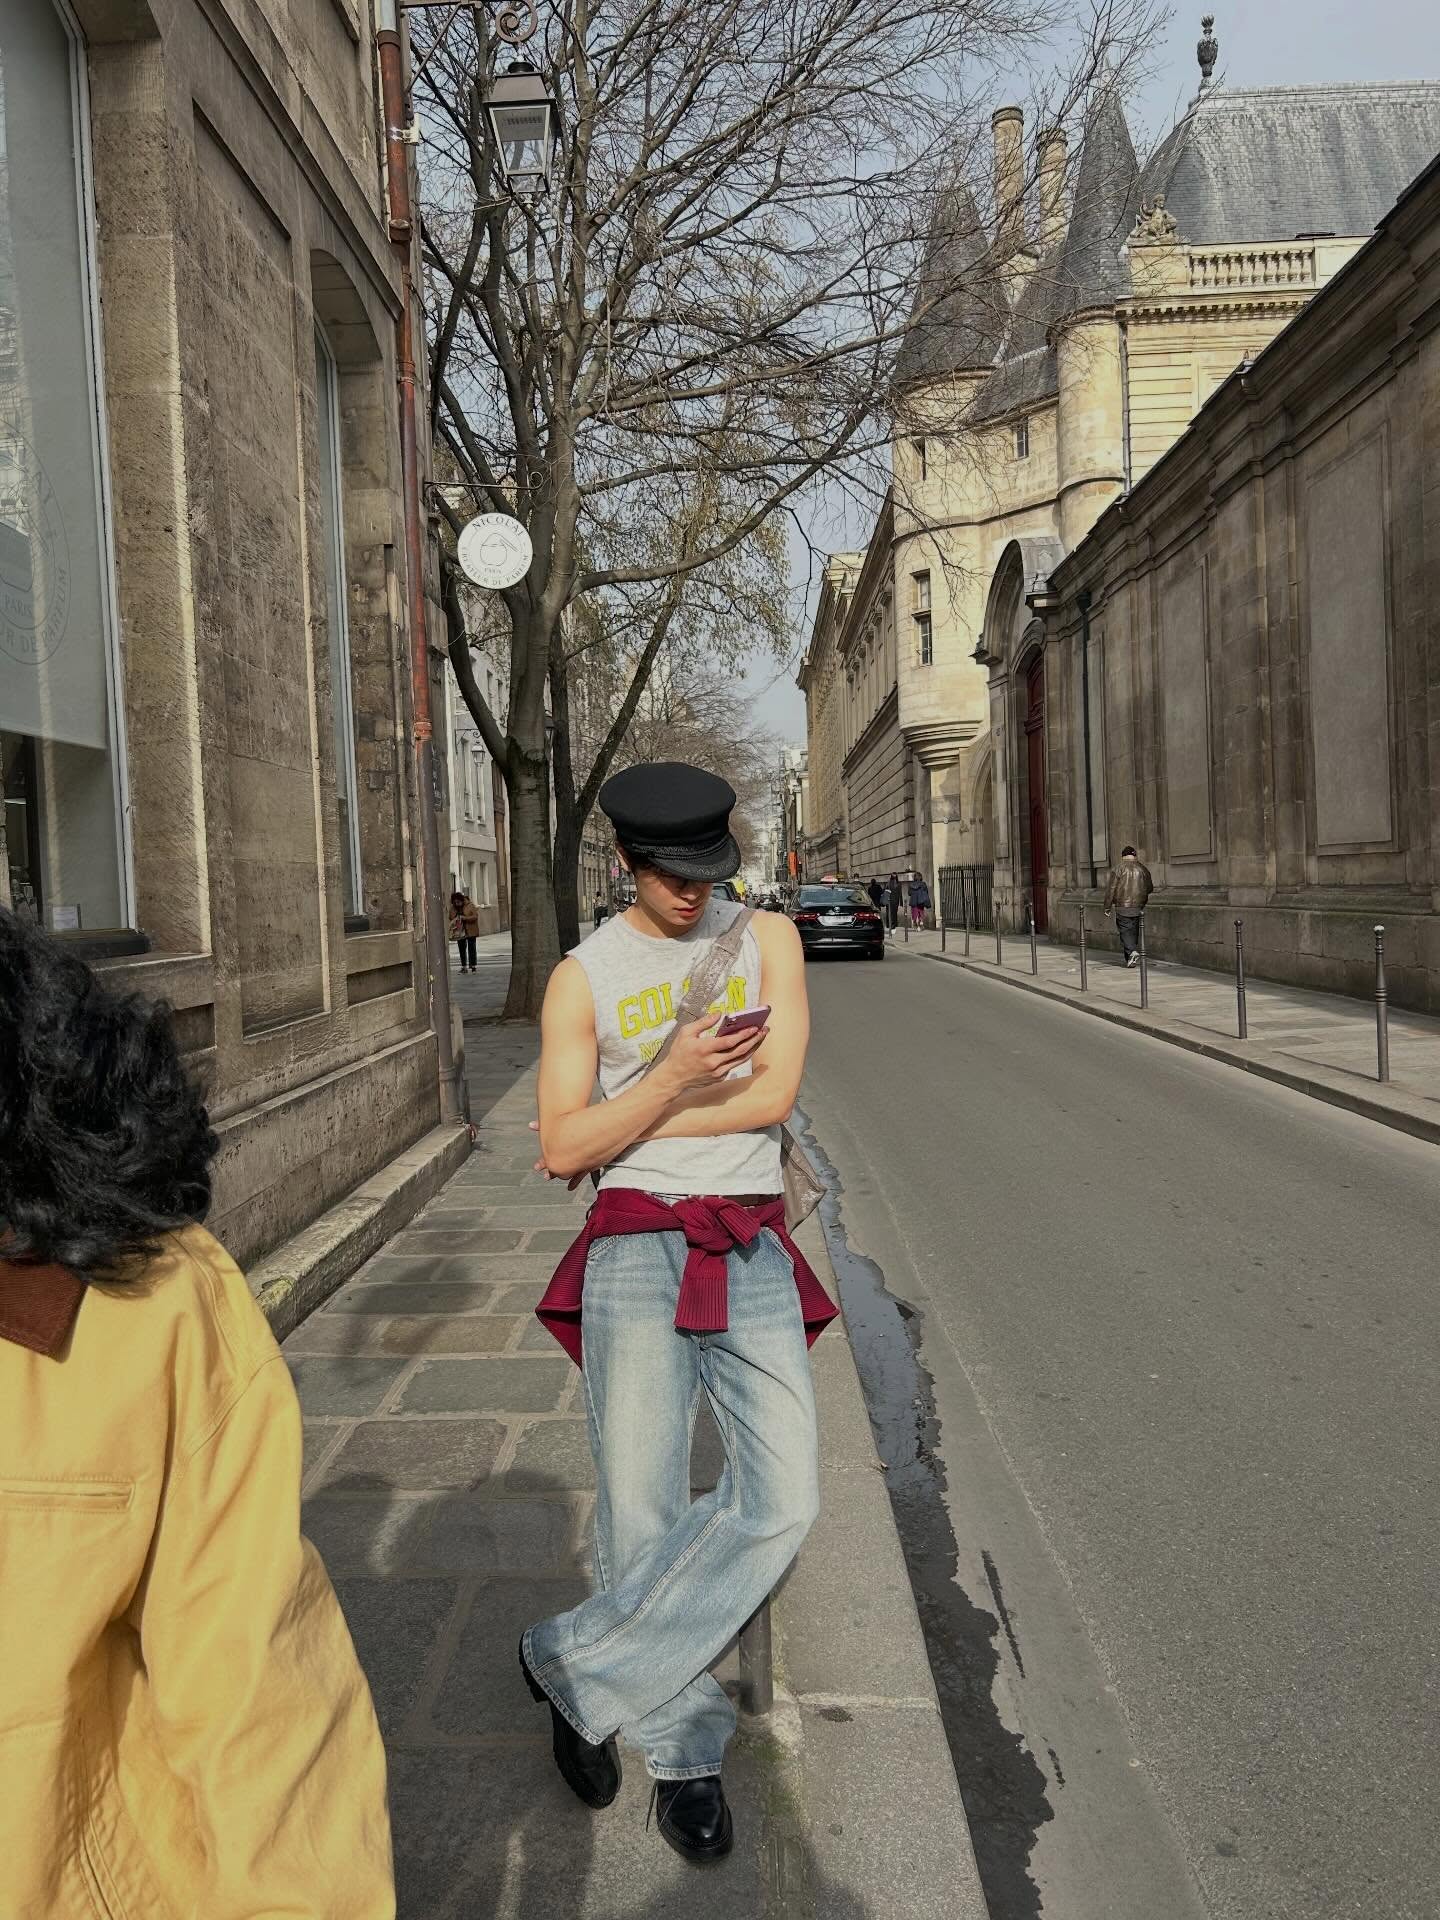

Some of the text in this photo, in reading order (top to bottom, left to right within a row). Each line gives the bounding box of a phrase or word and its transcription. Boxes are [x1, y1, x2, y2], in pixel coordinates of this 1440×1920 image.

[472, 516, 524, 537] NICOLAI
[5, 594, 33, 617] PARIS
[20, 568, 67, 653] DE PARFUM
[617, 976, 747, 1040] GOLN
